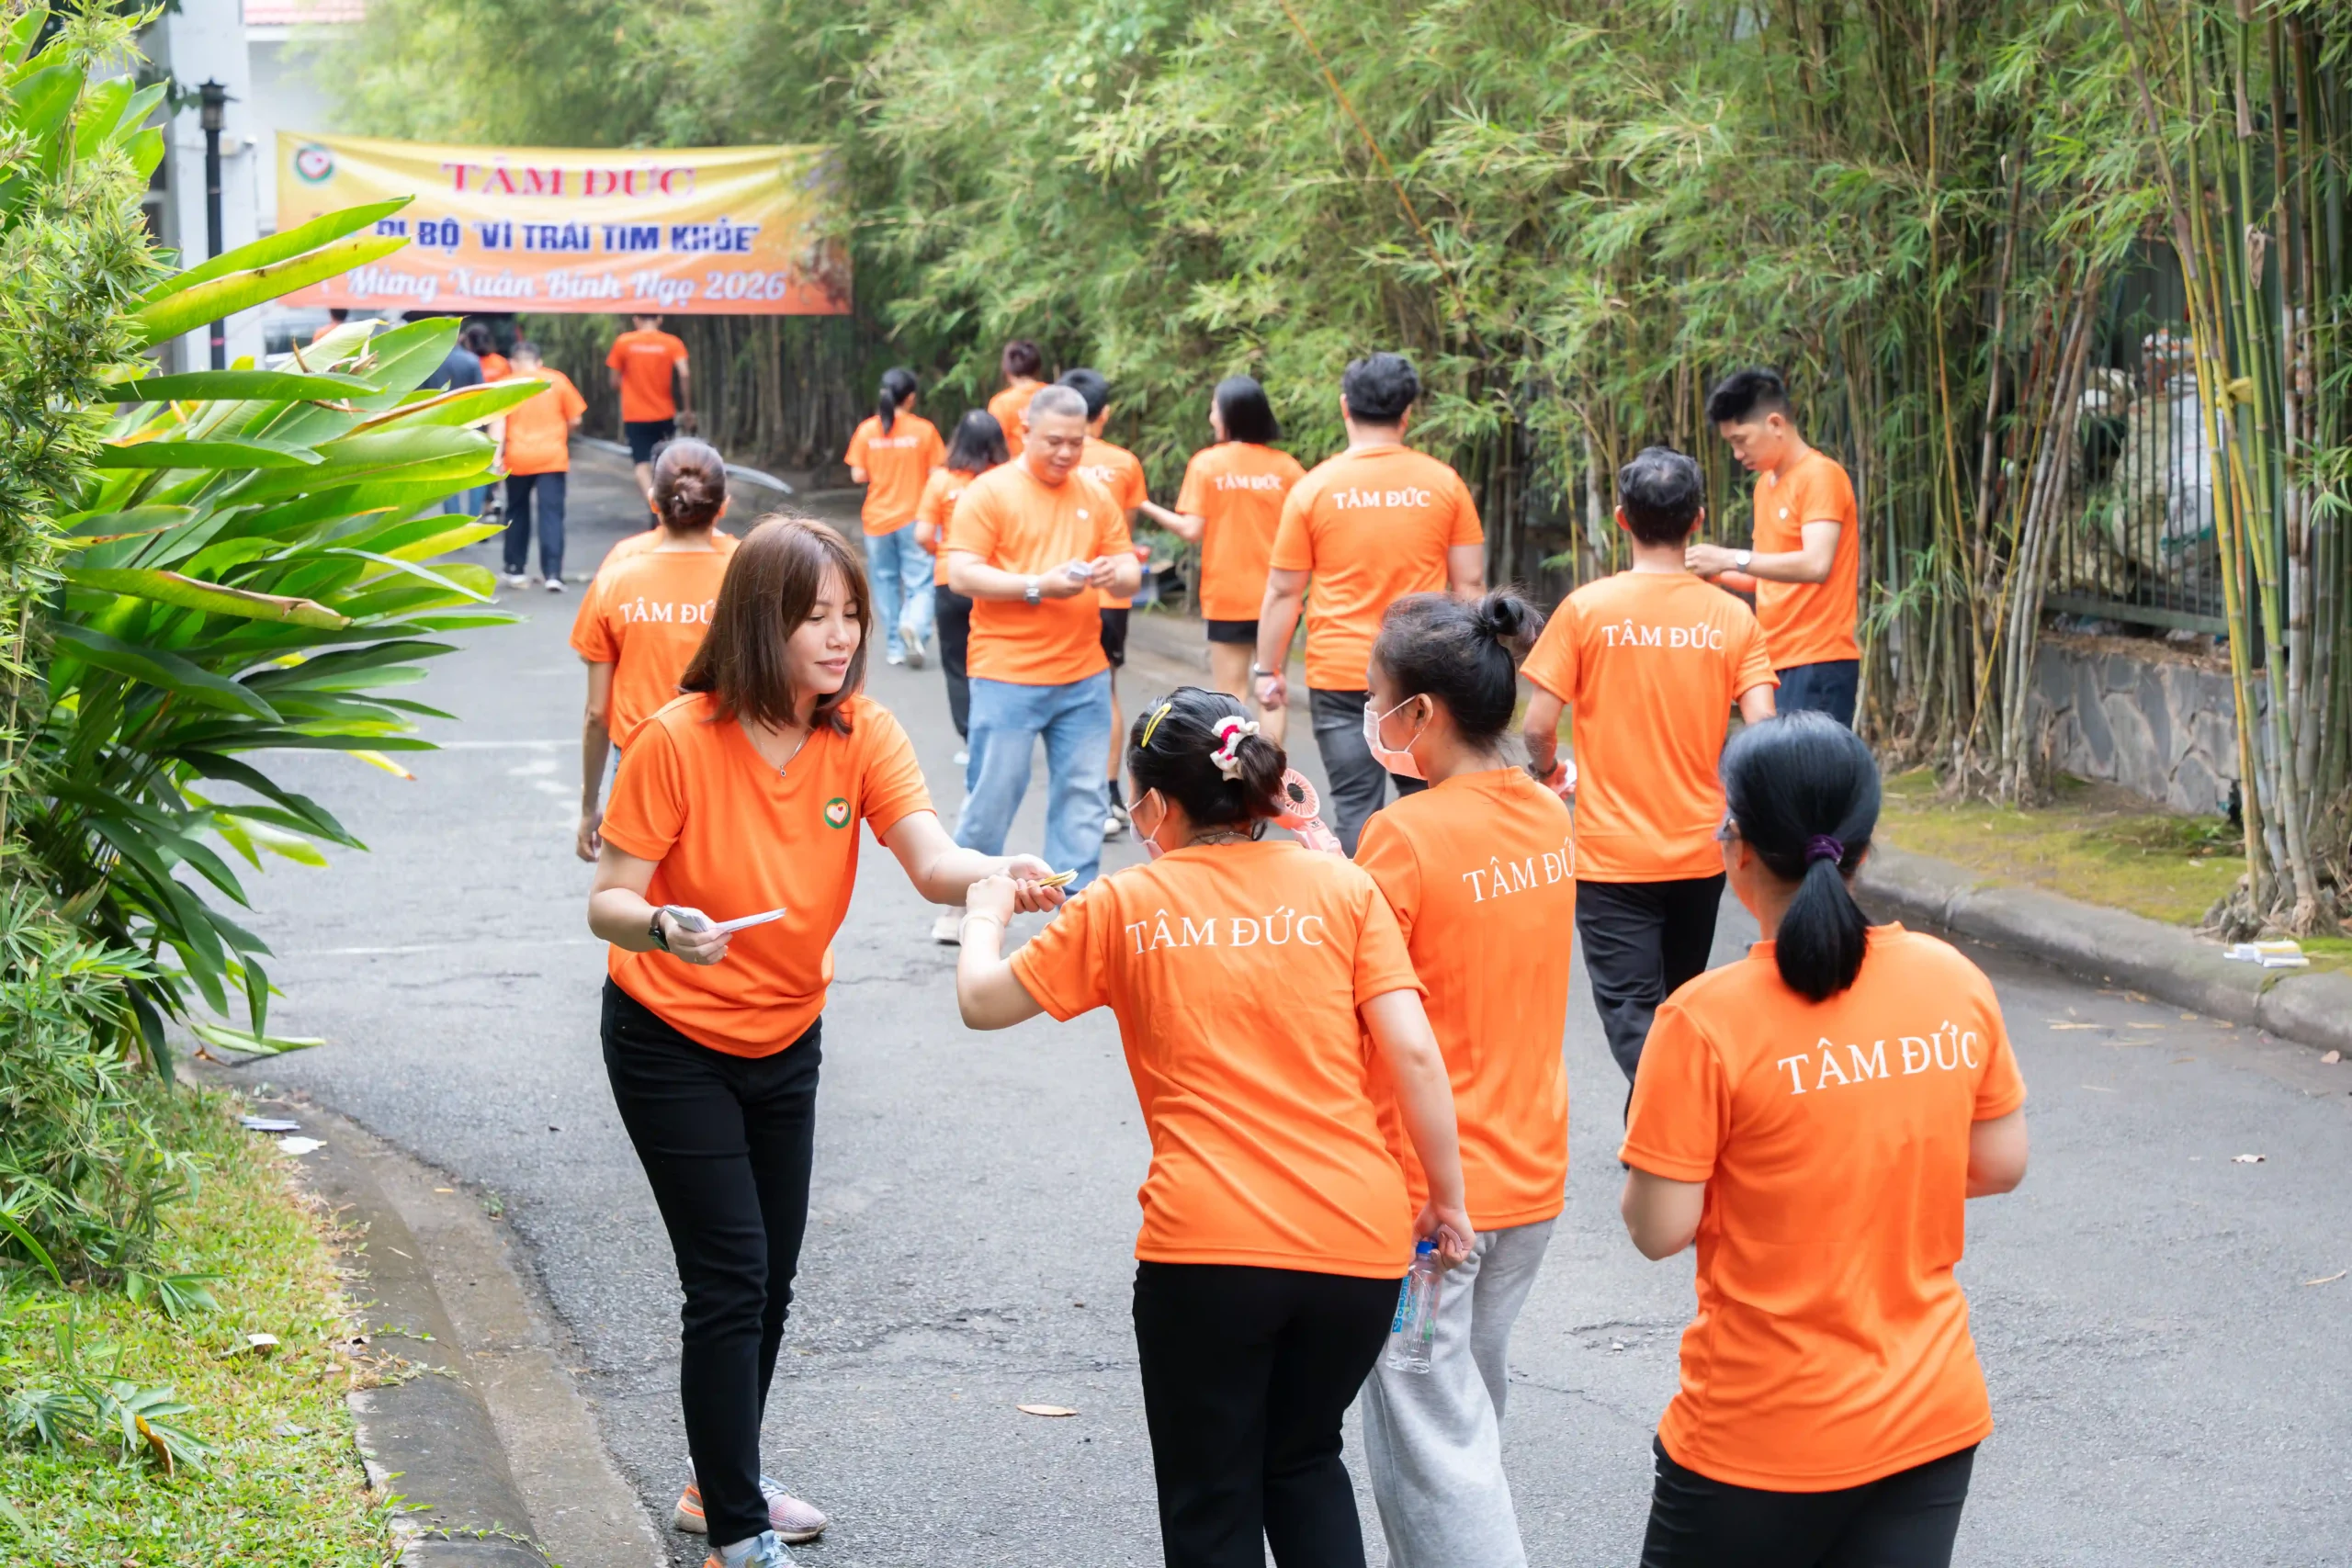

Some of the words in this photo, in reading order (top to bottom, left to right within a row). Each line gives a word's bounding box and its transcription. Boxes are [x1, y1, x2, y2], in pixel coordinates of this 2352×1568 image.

[441, 157, 563, 197] TÂM
[582, 161, 695, 197] ĐỨC
[418, 217, 459, 254] BỘ
[523, 223, 590, 250] TRÁI
[603, 226, 660, 250] TIM
[704, 272, 786, 301] 2026
[1333, 488, 1380, 509] TÂM
[1385, 487, 1430, 508] ĐỨC
[618, 596, 673, 624] TÂM
[1601, 618, 1663, 648] TÂM
[1668, 622, 1724, 650] ĐỨC
[1462, 855, 1540, 903] TÂM
[1125, 908, 1217, 955] TÂM
[1228, 905, 1324, 947] ĐỨC
[1777, 1037, 1892, 1095] TÂM
[1897, 1020, 1979, 1075] ĐỨC
